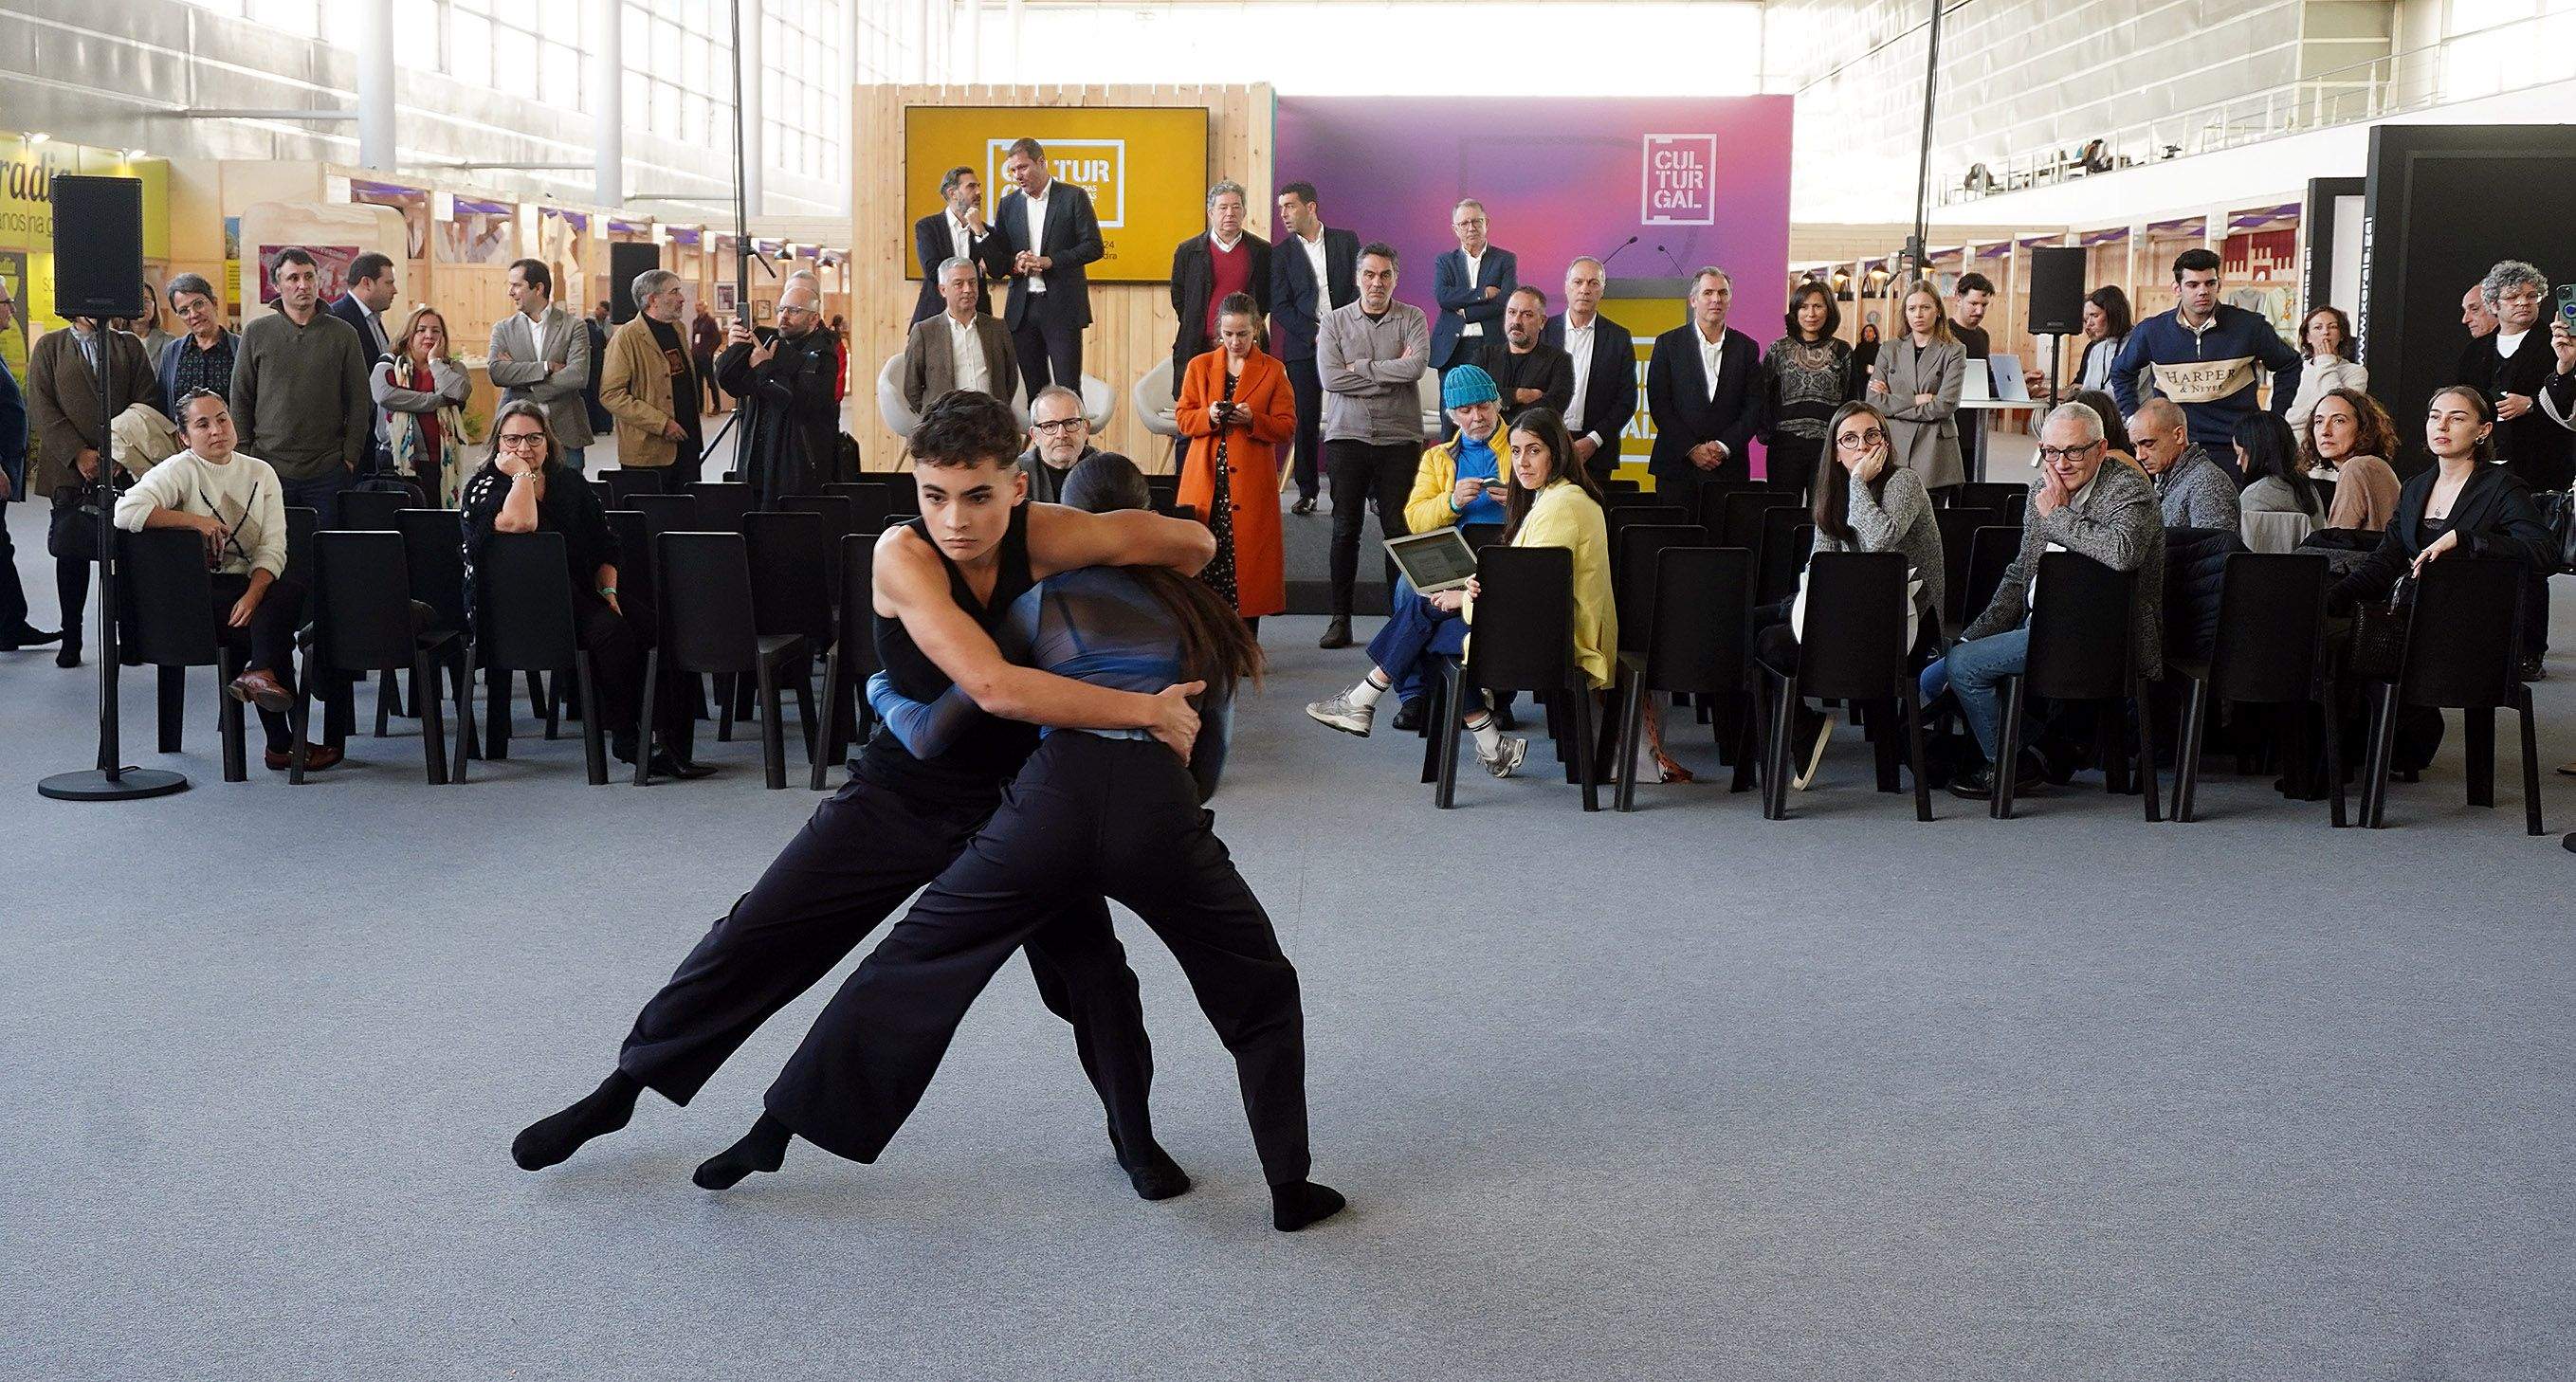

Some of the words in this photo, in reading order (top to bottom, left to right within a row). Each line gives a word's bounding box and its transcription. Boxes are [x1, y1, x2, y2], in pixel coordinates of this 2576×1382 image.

[1654, 151, 1704, 169] CUL
[0, 152, 72, 202] radi
[1000, 159, 1110, 182] CTUR
[1655, 170, 1704, 189] TUR
[1653, 190, 1702, 209] GAL
[2165, 369, 2236, 384] HARPER
